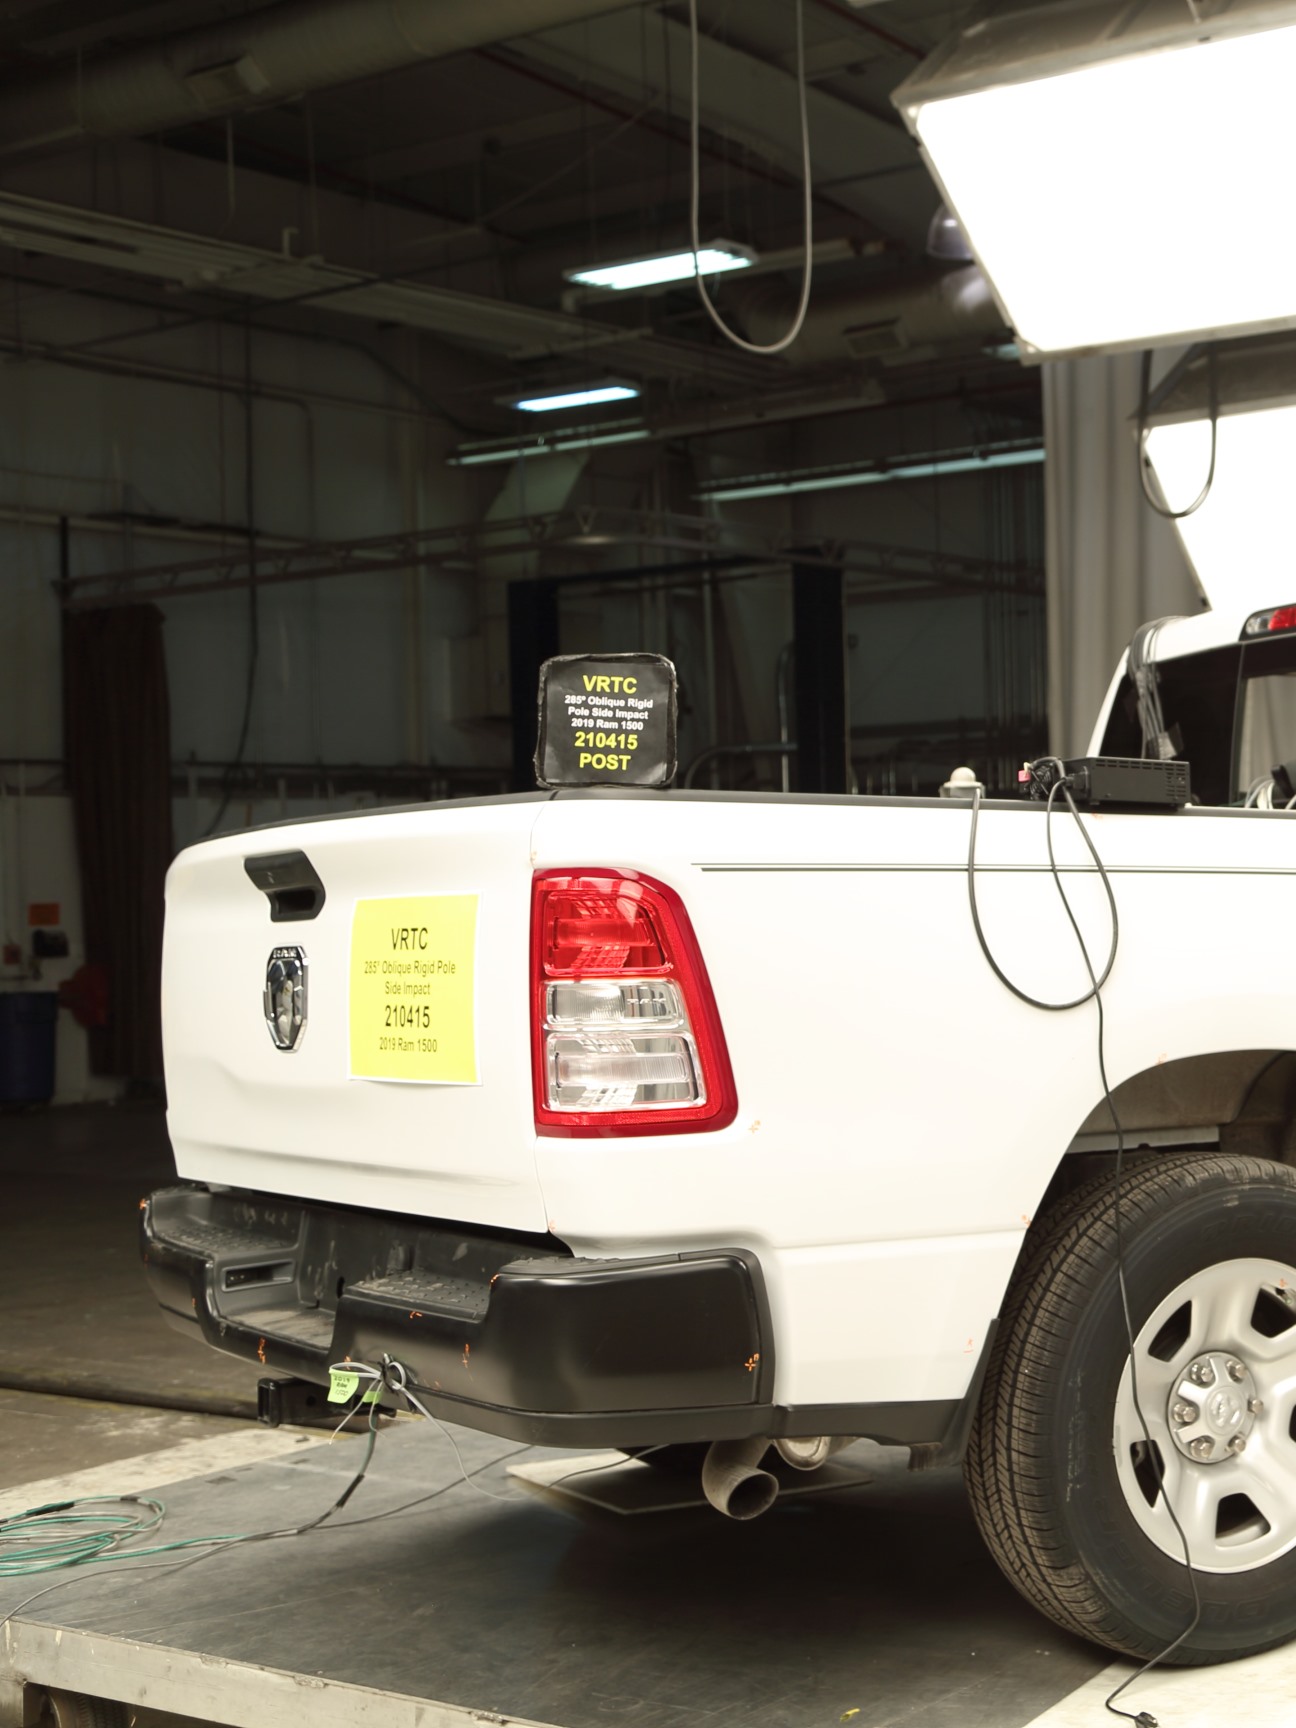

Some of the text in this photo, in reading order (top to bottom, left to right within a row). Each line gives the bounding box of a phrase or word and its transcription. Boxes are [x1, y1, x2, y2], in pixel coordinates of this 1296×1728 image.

[582, 675, 638, 694] VRTC
[587, 696, 626, 708] Oblique
[627, 697, 654, 709] Rigid
[567, 706, 649, 720] Pole Side Impact
[571, 718, 644, 731] 2019 Ram 1500
[574, 731, 638, 750] 210415
[579, 752, 632, 771] POST
[391, 926, 429, 950] VRTC
[382, 960, 412, 977] Oblique
[413, 960, 435, 978] Rigid
[437, 960, 456, 974] Pole
[384, 980, 431, 998] Side Impact
[384, 1004, 431, 1029] 210415
[379, 1036, 438, 1053] 2019 Ram 1500
